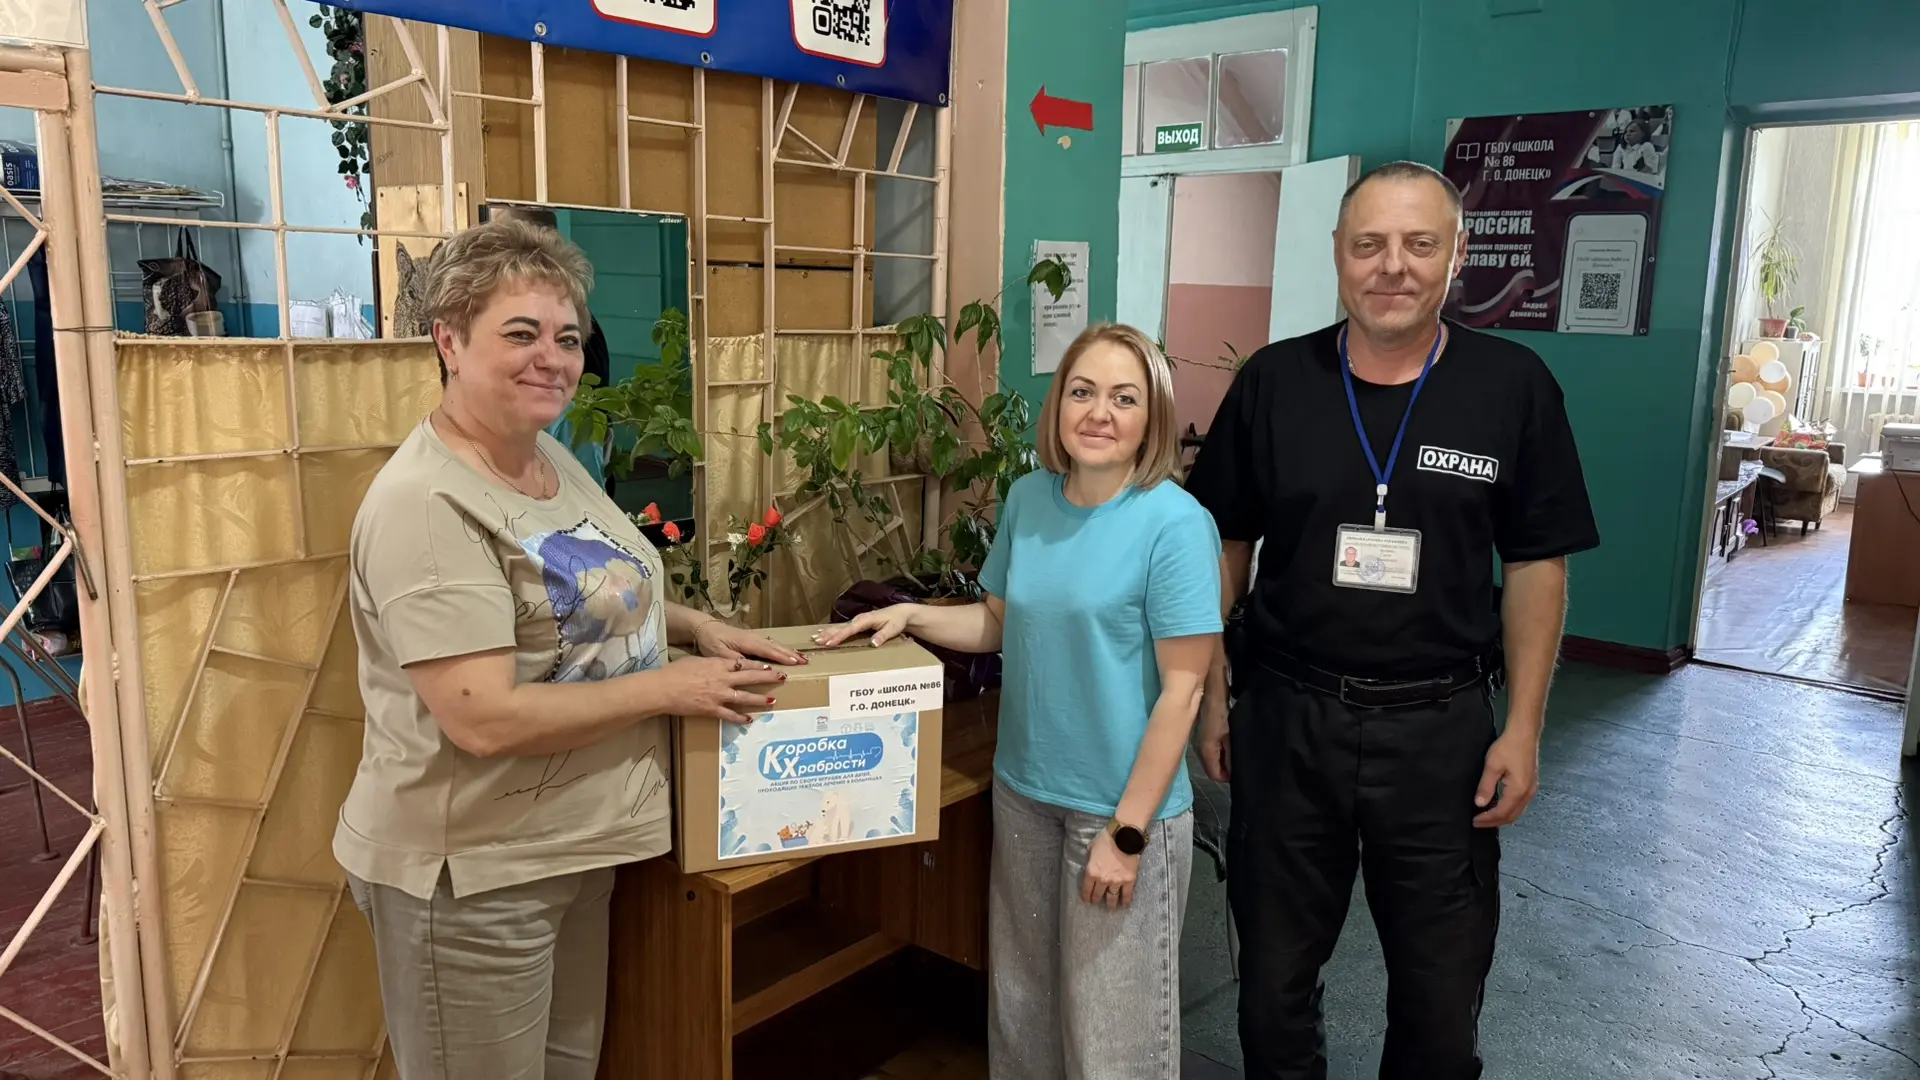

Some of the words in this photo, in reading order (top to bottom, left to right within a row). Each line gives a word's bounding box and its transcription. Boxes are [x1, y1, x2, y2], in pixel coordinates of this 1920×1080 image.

[1157, 128, 1199, 145] ВЫХОД
[1484, 141, 1511, 154] ГБОУ
[1512, 139, 1555, 153] «ШКОЛА
[1484, 156, 1501, 168] №
[1502, 155, 1516, 167] 86
[4, 162, 14, 186] oasis
[1483, 170, 1492, 182] Г.
[1494, 169, 1503, 181] О.
[1504, 168, 1552, 182] ДОНЕЦК»
[1464, 216, 1535, 235] РОССИЯ.
[1494, 243, 1532, 251] приносят
[1510, 250, 1535, 267] ей.
[1423, 450, 1494, 478] ОХРАНА
[849, 688, 875, 698] ГБОУ
[877, 683, 918, 696] «ШКОЛА
[919, 680, 942, 692] №86
[850, 702, 869, 712] Г.О.
[870, 697, 916, 711] ДОНЕЦК»
[761, 737, 848, 775] Коробка
[781, 756, 866, 779] Храбрости
